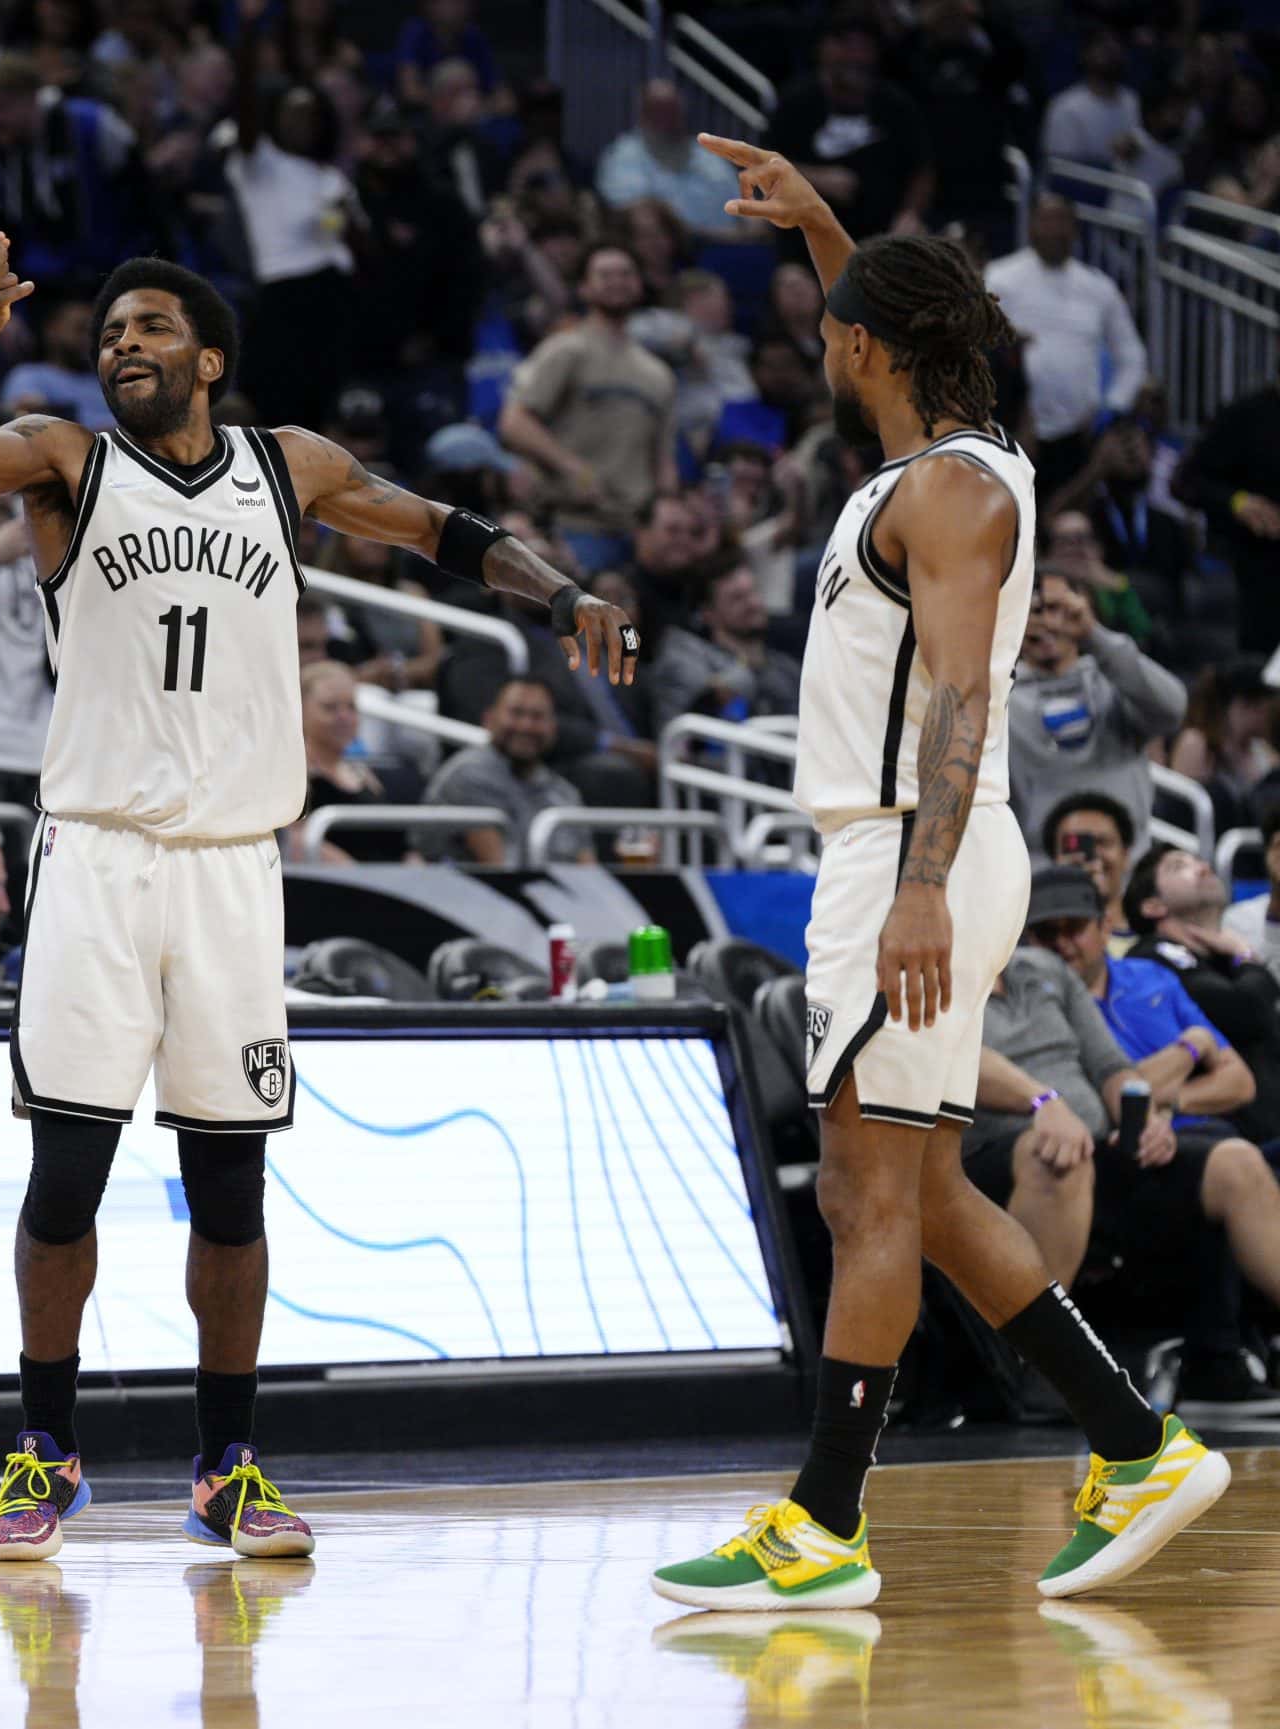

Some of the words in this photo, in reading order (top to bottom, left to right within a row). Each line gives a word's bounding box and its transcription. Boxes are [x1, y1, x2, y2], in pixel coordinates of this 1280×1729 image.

[236, 497, 266, 507] Webull
[92, 526, 279, 599] BROOKLYN
[159, 605, 208, 692] 11
